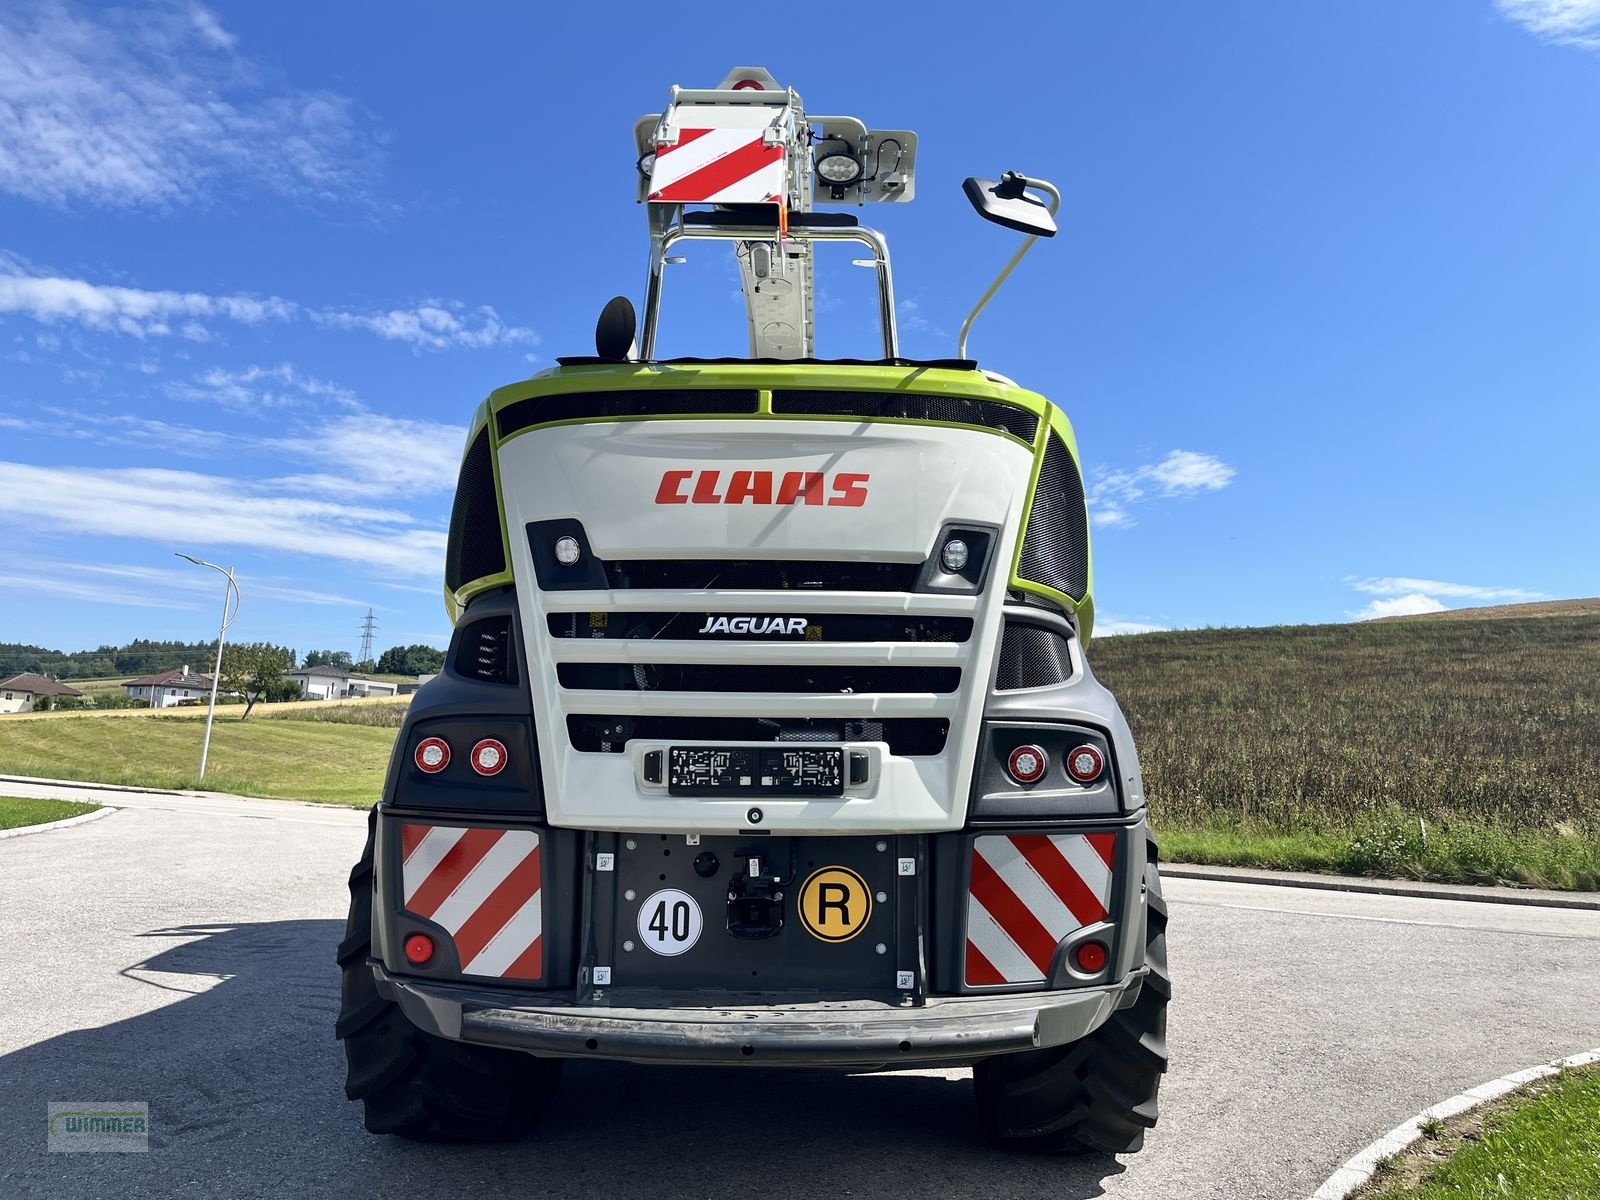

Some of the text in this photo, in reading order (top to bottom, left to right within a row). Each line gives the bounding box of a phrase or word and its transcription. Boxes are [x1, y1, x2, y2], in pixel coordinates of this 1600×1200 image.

[655, 471, 870, 507] CLAAS
[699, 617, 808, 634] JAGUAR
[648, 900, 690, 942] 40
[818, 882, 851, 925] R
